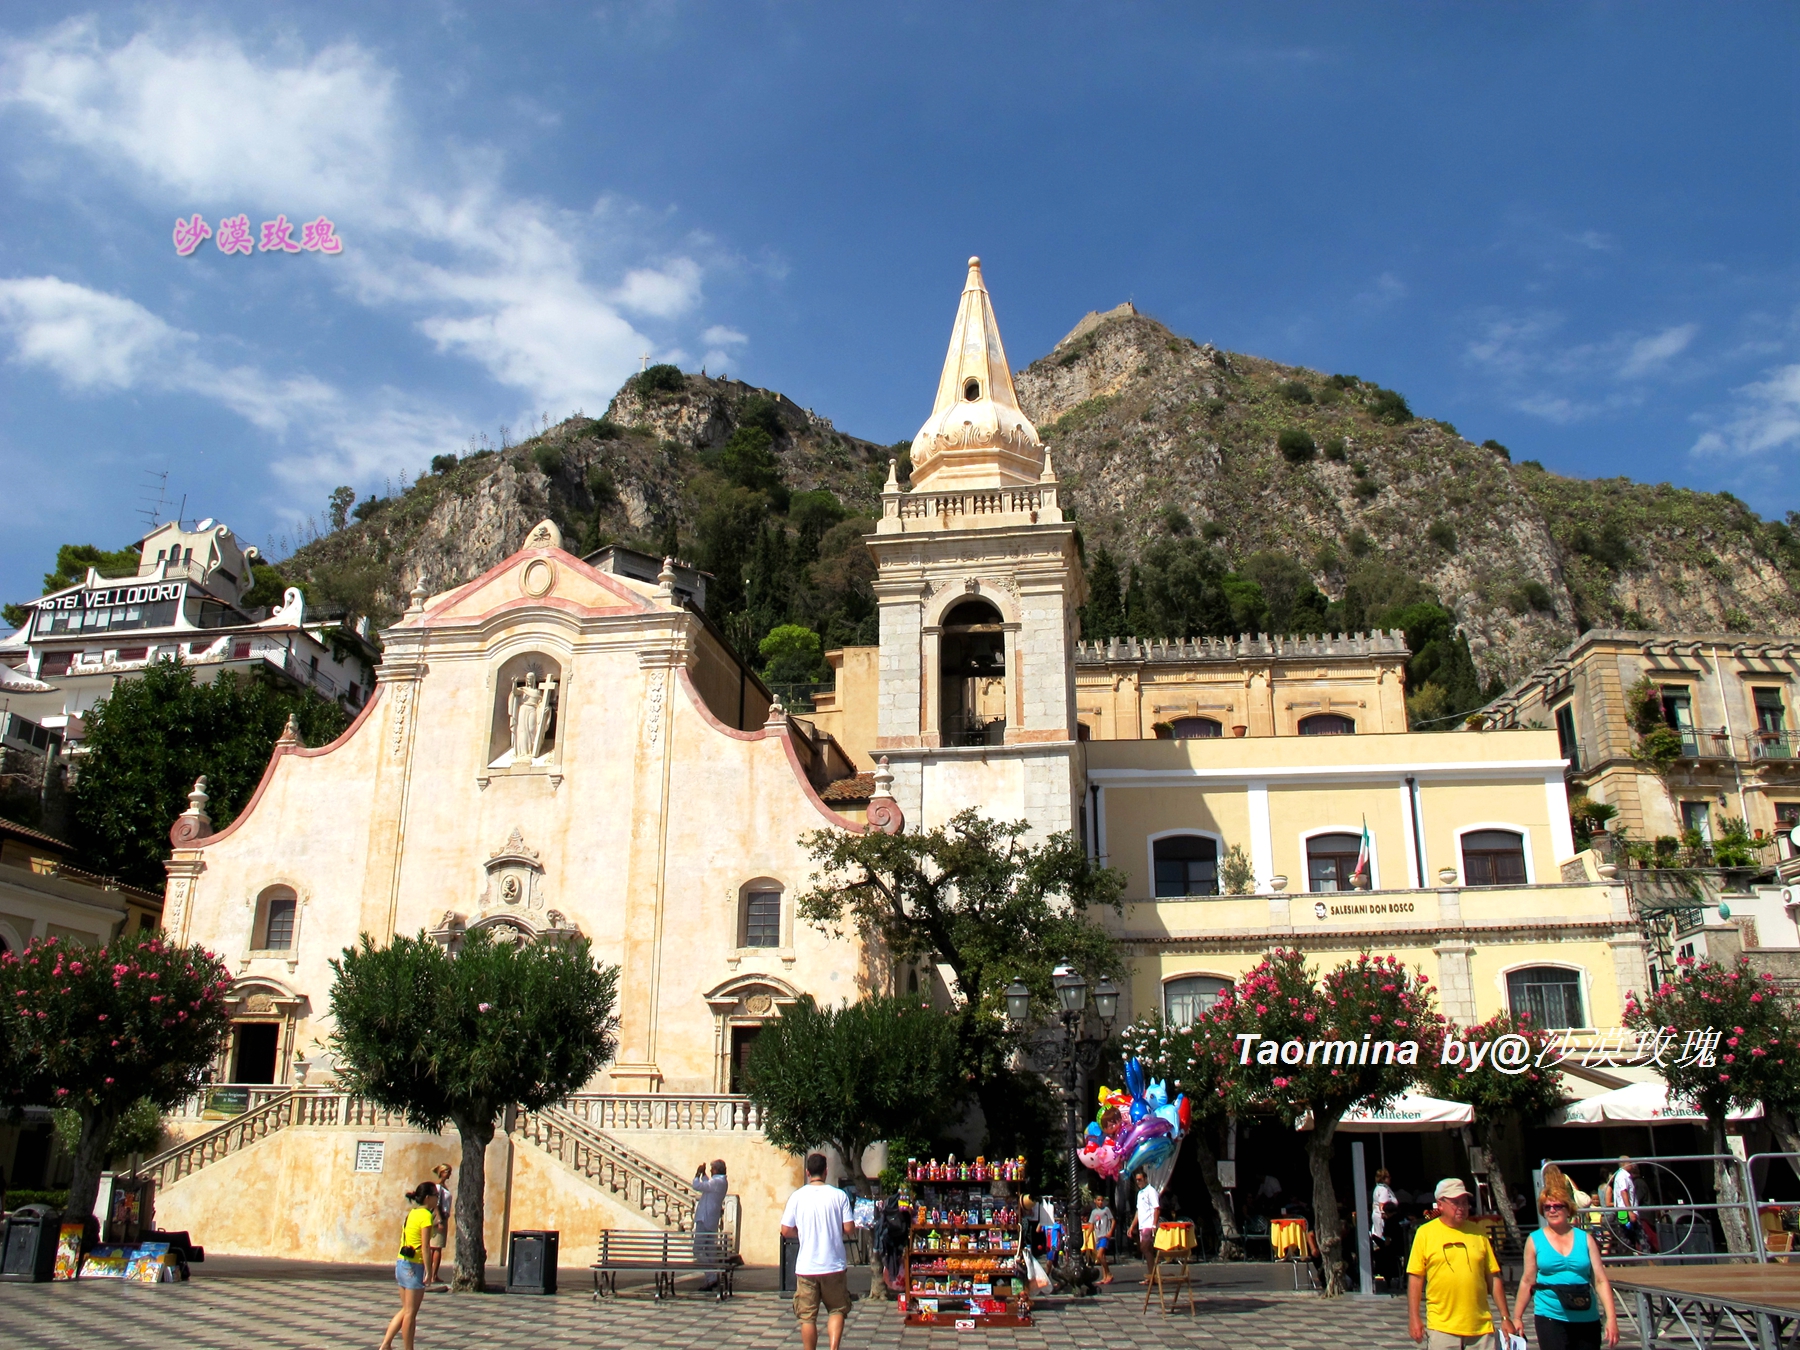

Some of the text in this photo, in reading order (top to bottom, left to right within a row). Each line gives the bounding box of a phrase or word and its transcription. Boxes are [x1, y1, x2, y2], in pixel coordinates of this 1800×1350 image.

[1331, 902, 1415, 915] SALESIANI DON BOSCO
